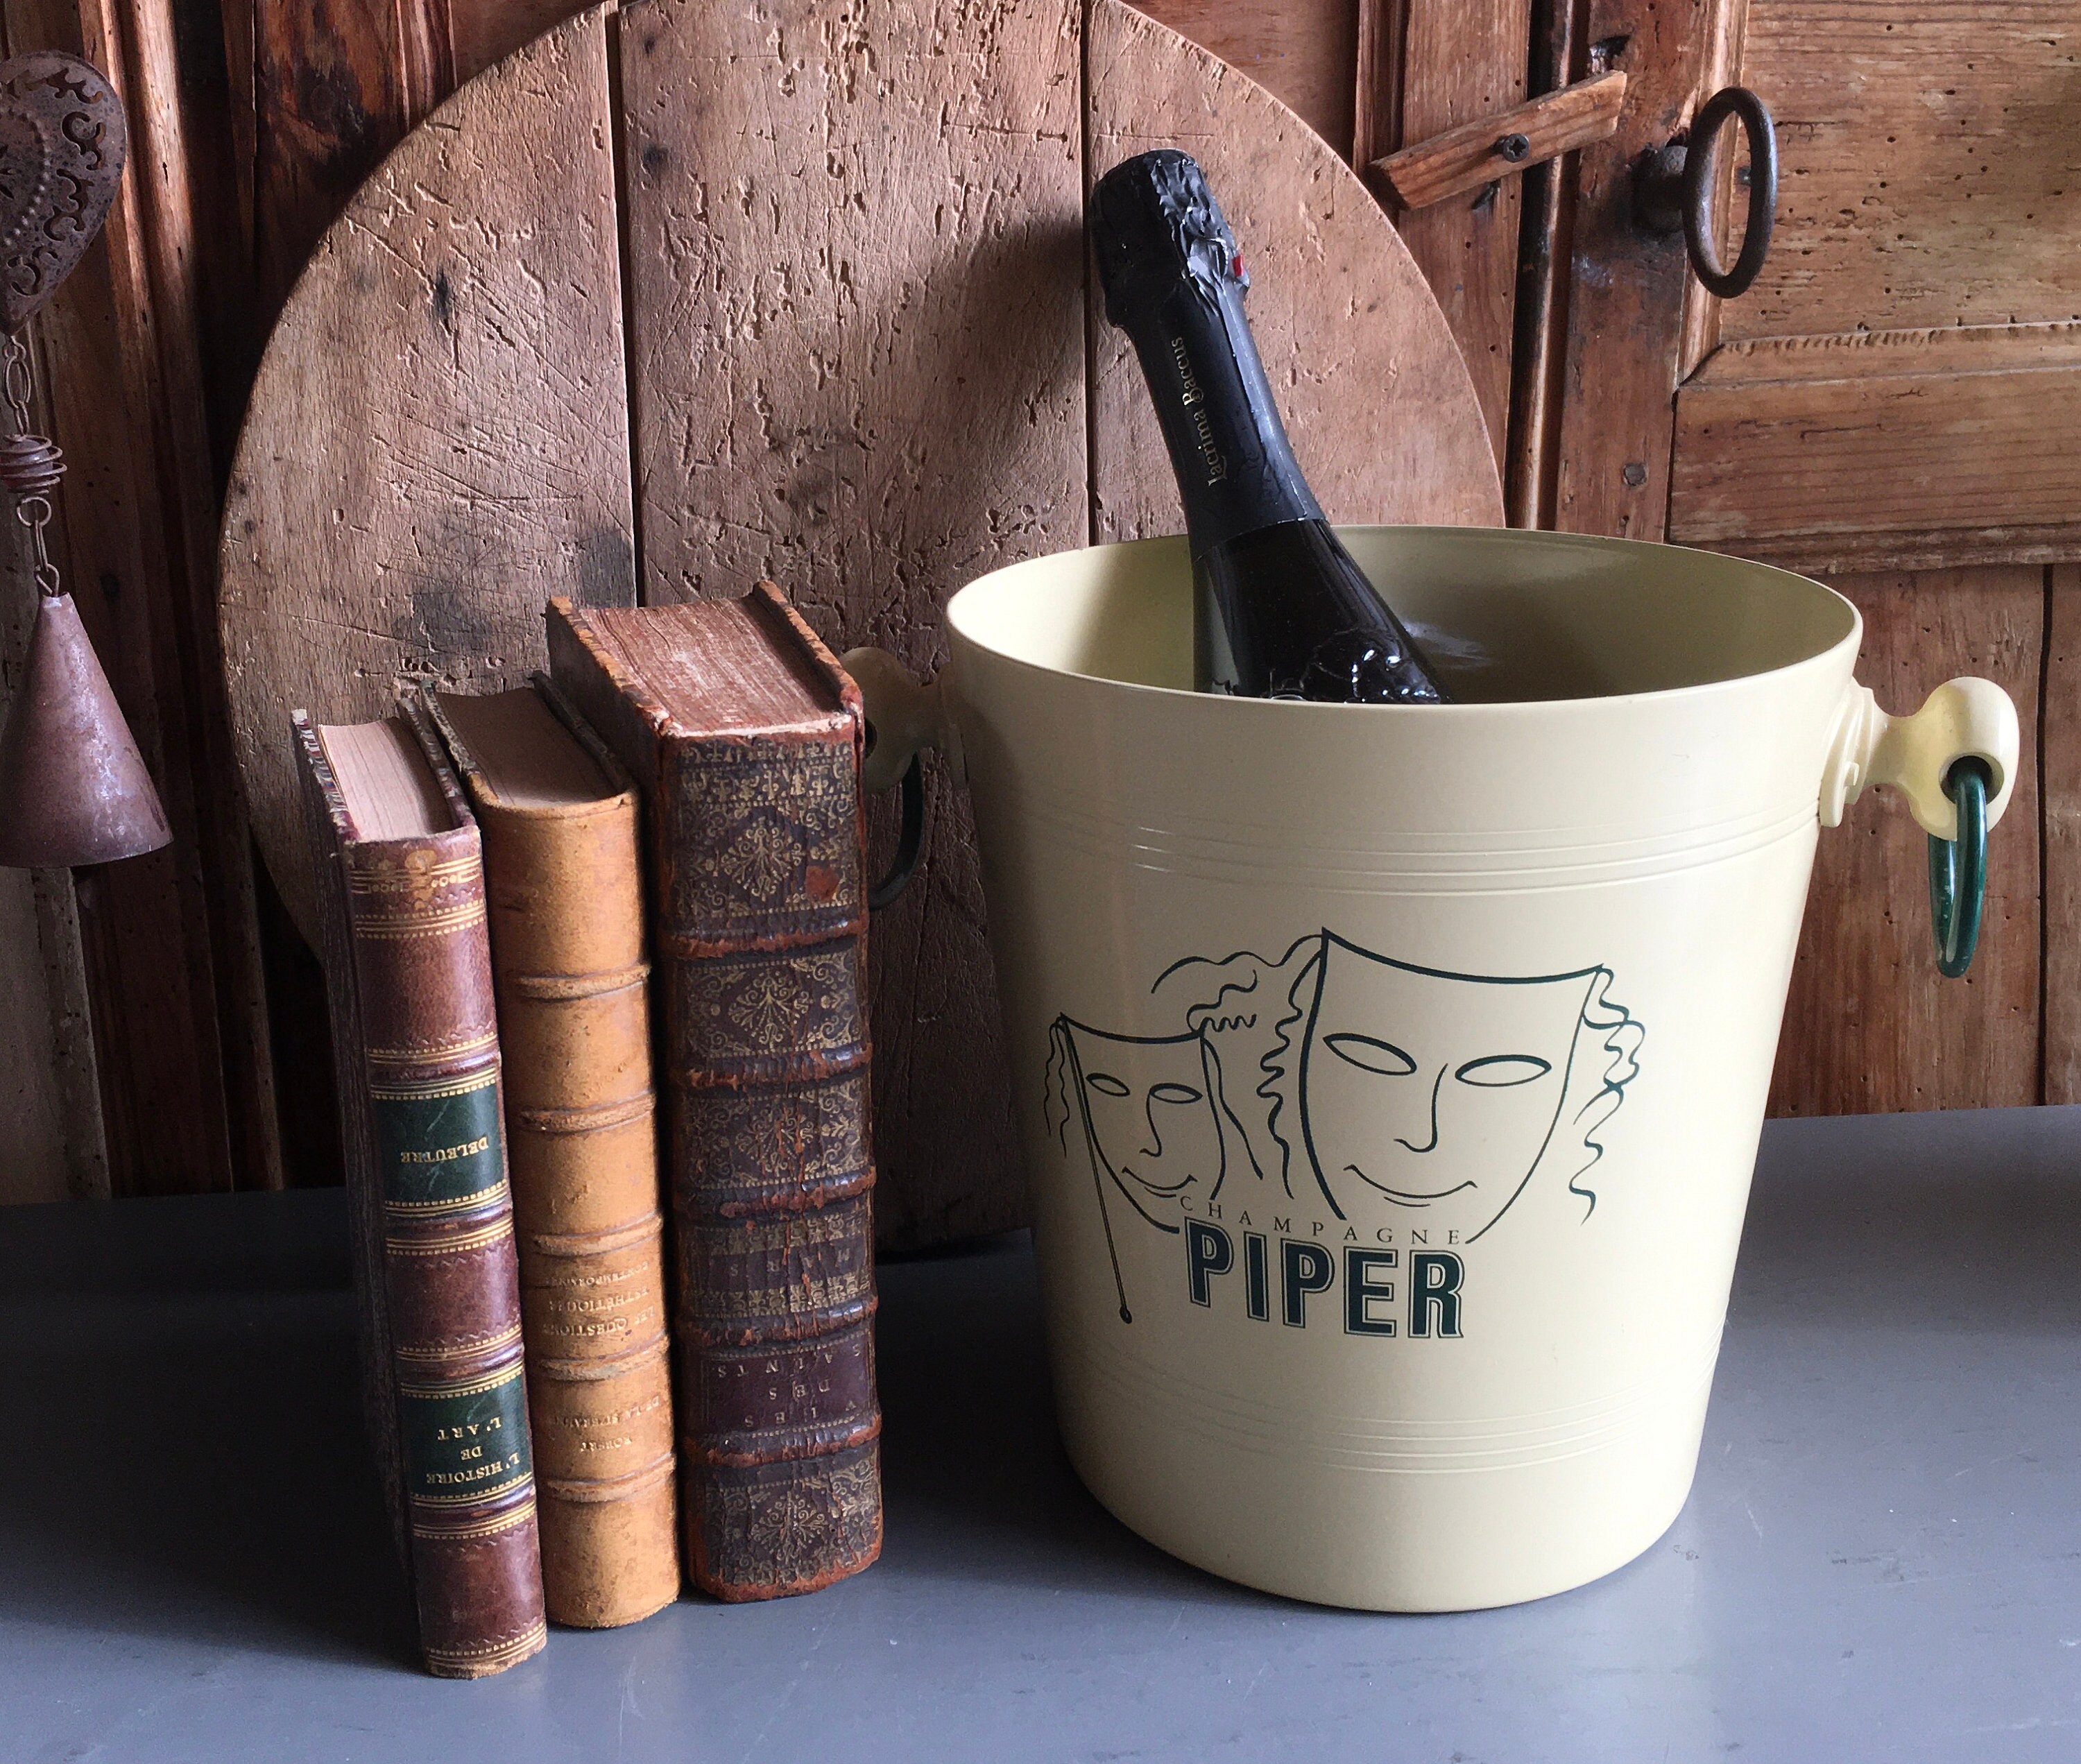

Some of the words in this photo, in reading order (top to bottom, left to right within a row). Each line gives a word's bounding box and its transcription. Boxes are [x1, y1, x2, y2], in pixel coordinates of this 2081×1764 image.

[1171, 336, 1204, 406] Baccus
[1193, 409, 1227, 487] Lacrima
[400, 1136, 489, 1164] DELEUTRE
[1180, 1195, 1460, 1246] CHAMPAGNE
[1184, 1216, 1466, 1339] PIPER
[768, 1378, 831, 1401] DES
[425, 1451, 520, 1485] L'HISTOIRE
[460, 1446, 483, 1462] DE
